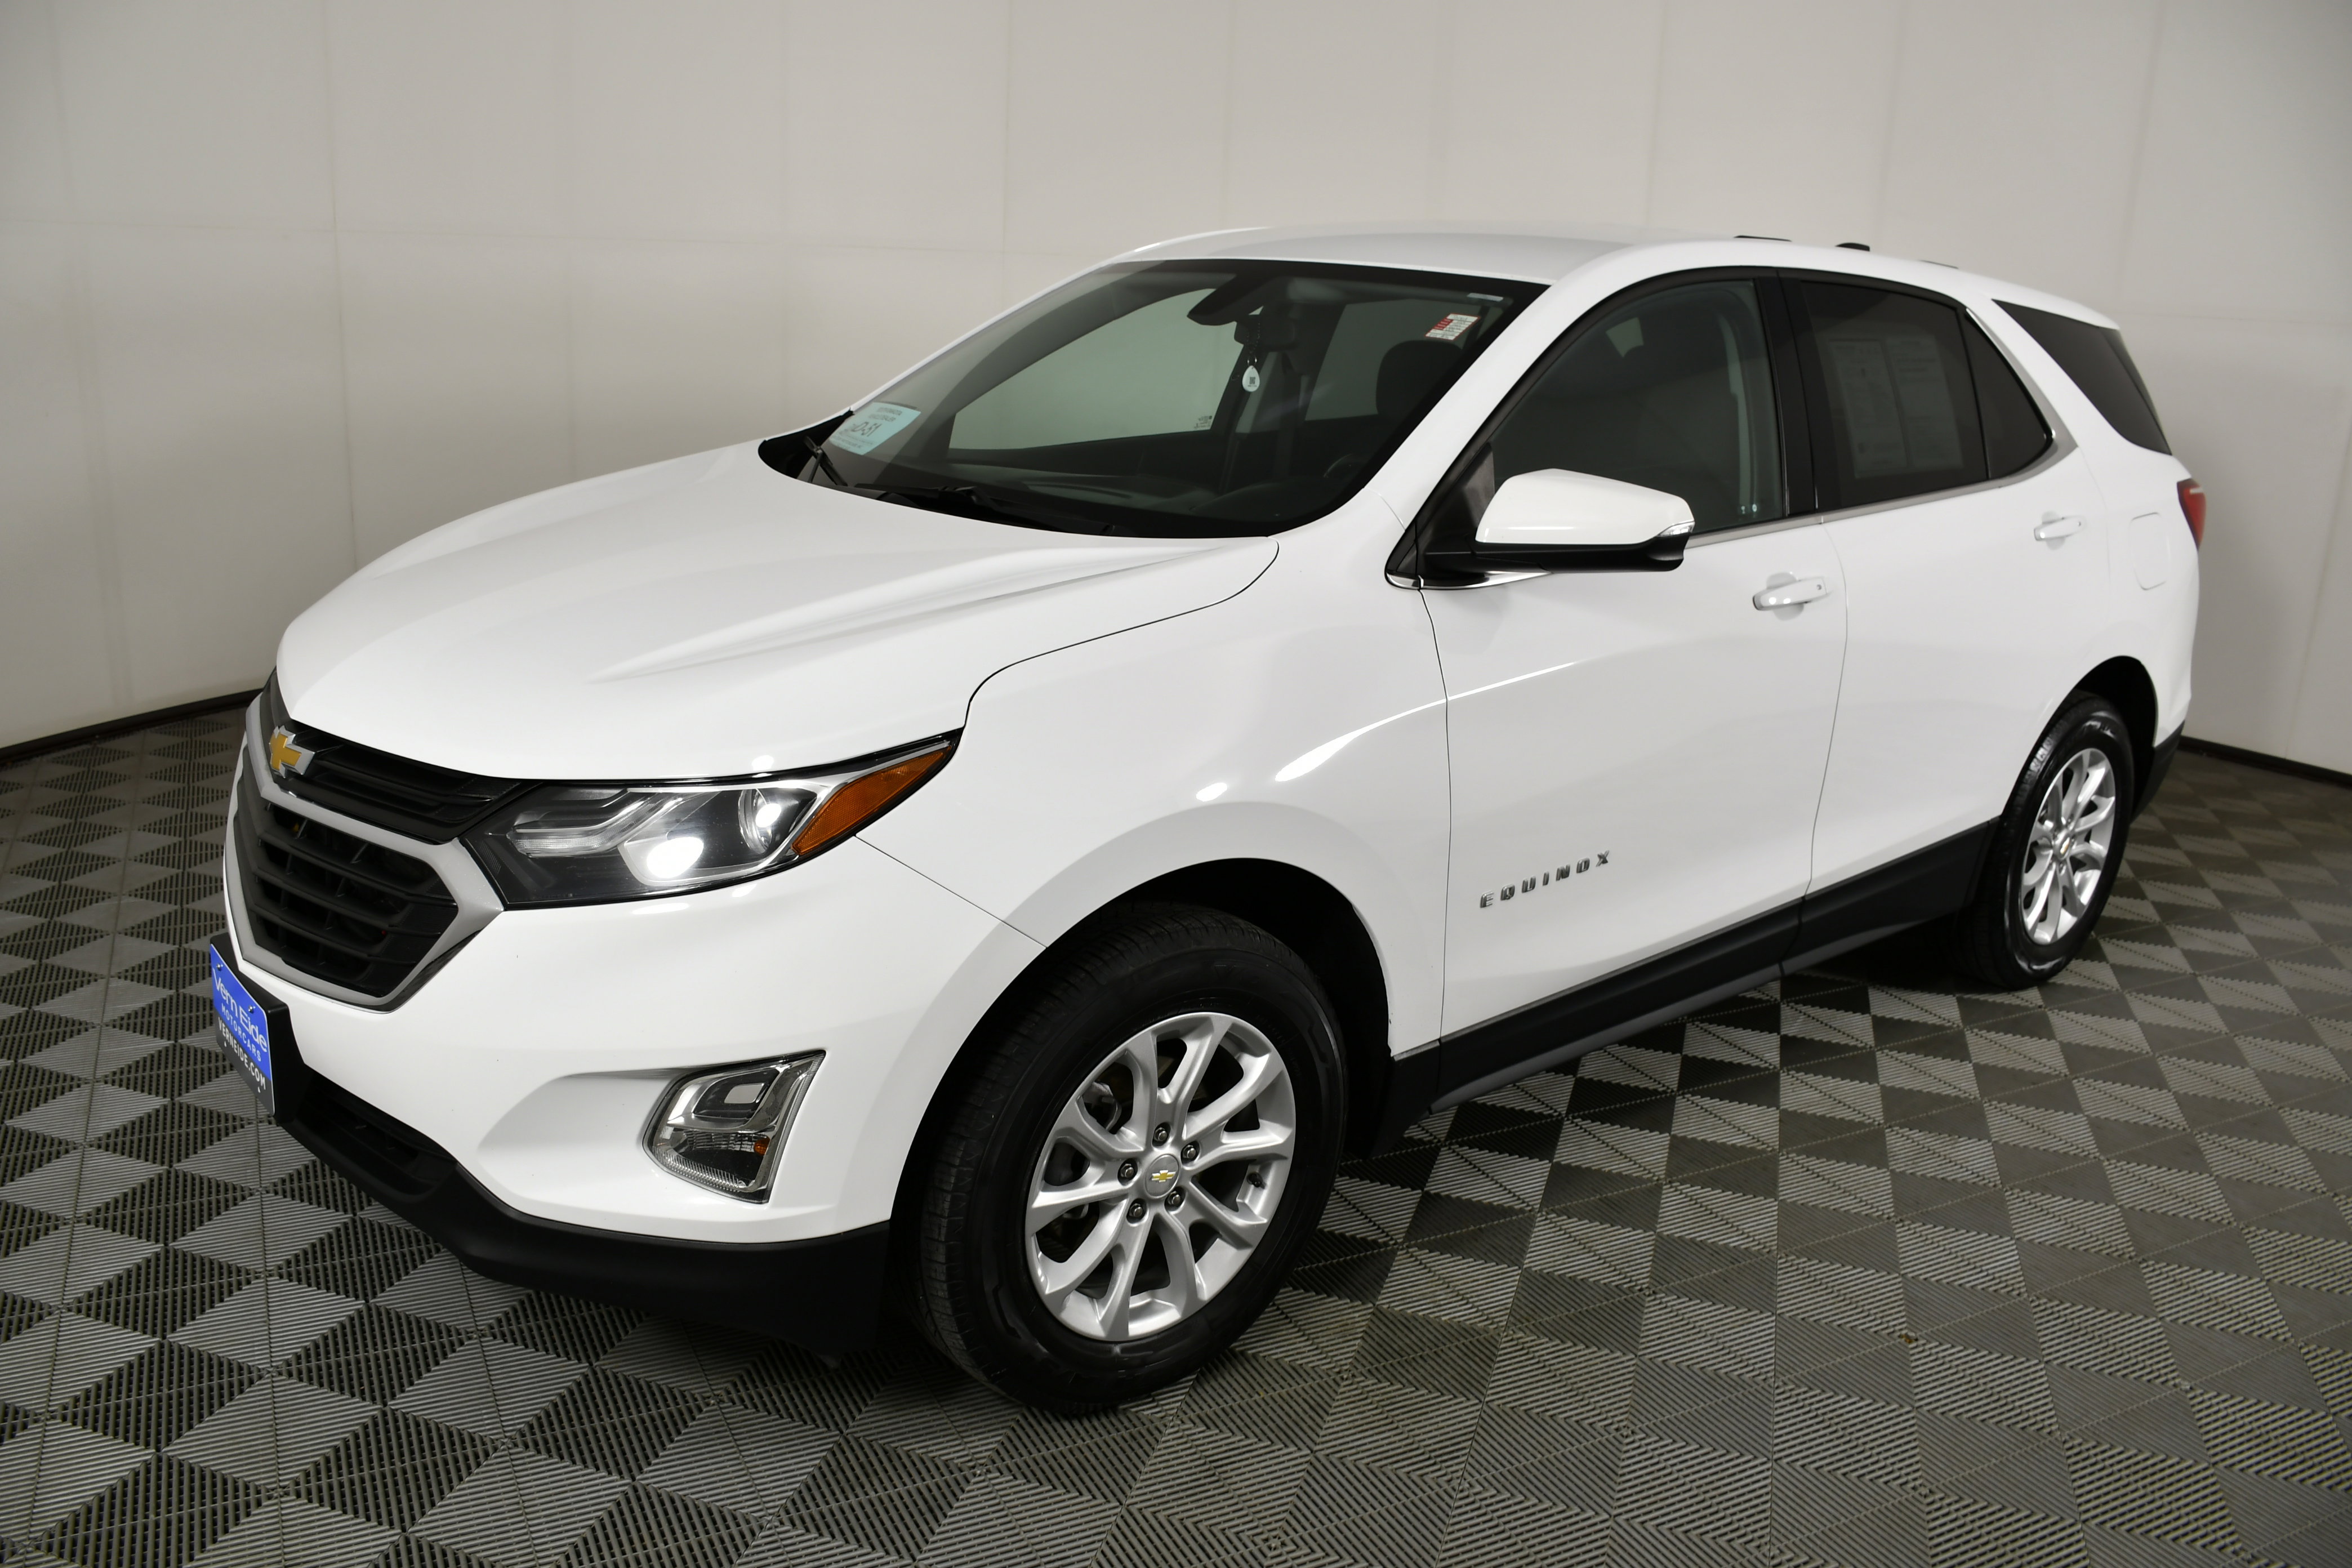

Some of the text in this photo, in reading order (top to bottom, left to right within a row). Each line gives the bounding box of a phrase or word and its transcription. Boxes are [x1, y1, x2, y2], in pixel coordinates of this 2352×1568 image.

[1480, 850, 1610, 908] EQUINOX
[213, 968, 268, 1052] Vern Eide
[221, 1003, 261, 1062] MOTORCARS
[218, 1017, 266, 1090] VERNEIDE.COM
